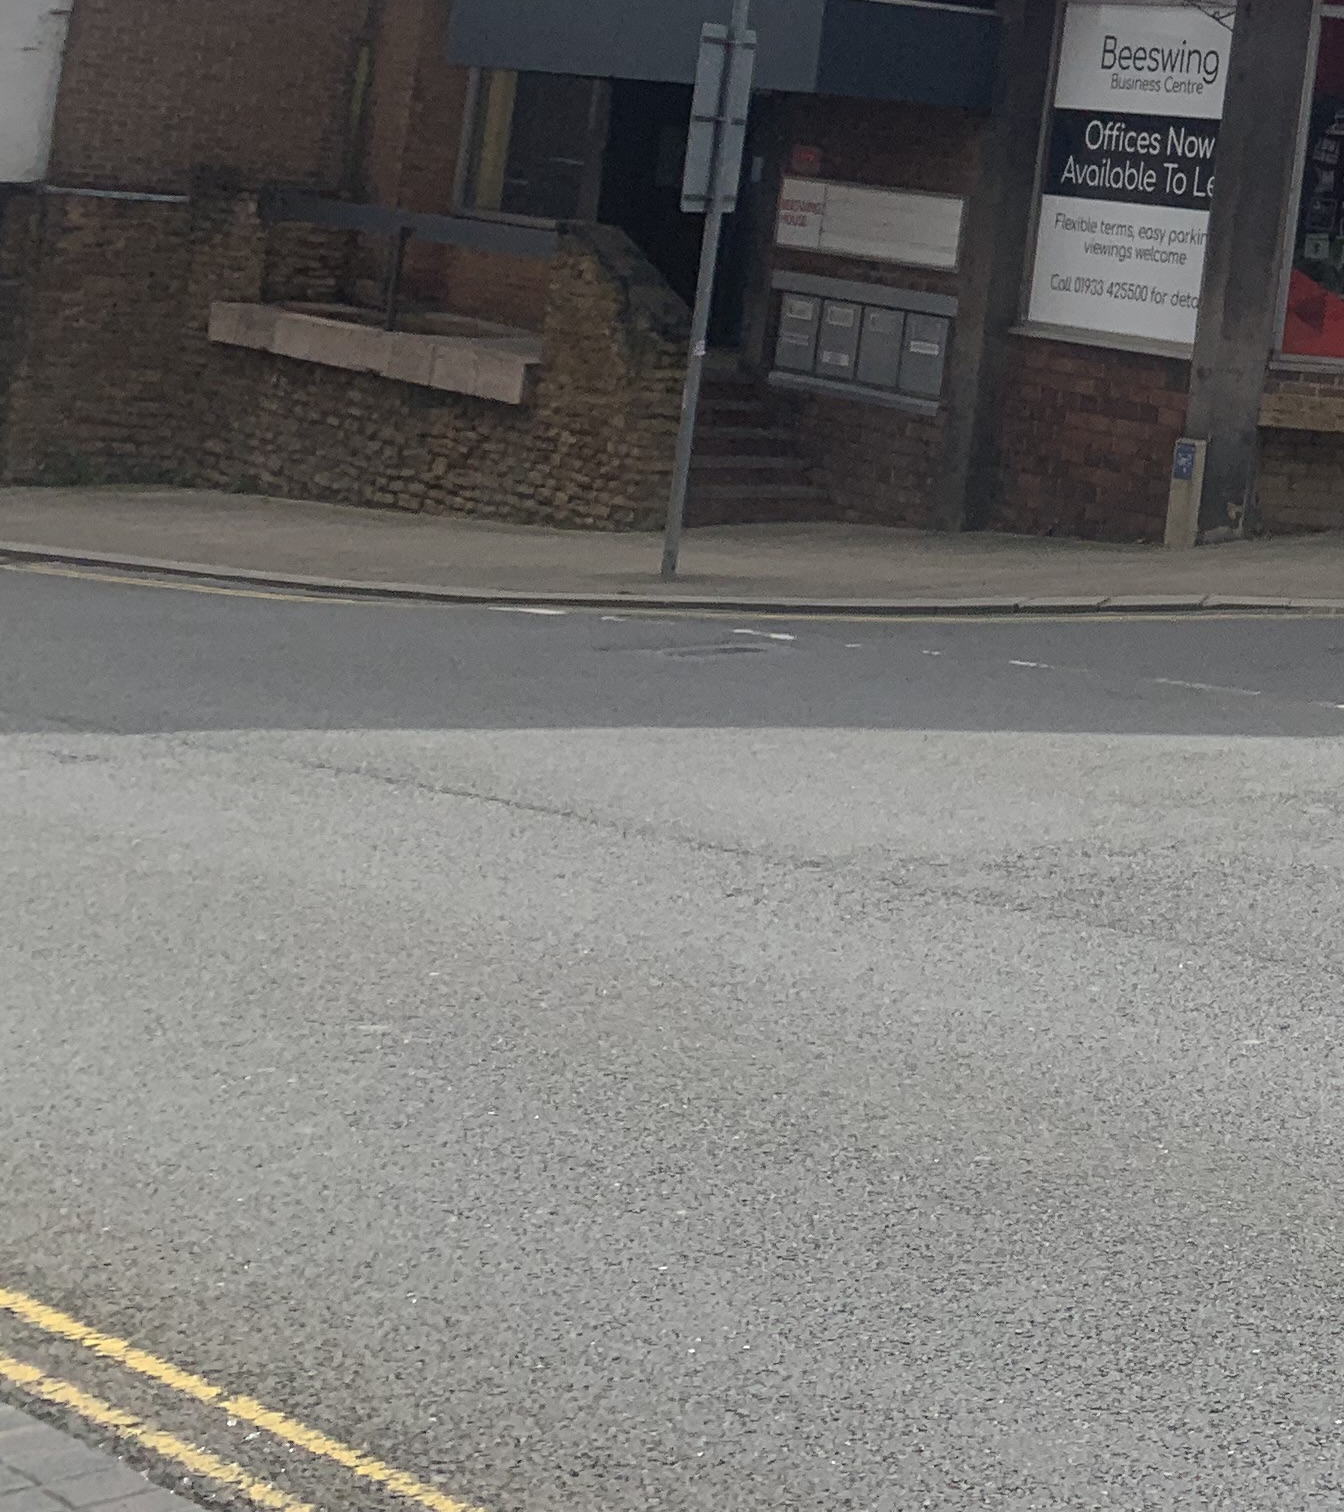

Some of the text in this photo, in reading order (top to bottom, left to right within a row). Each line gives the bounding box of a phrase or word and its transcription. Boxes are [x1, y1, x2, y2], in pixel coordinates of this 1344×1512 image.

[1101, 34, 1220, 84] Beeswing
[1110, 73, 1204, 95] Business Centre
[1084, 119, 1216, 160] Offices Now
[1060, 154, 1215, 198] Available To Le
[1054, 211, 1210, 248] Flexible terms, easy parkin
[1083, 241, 1187, 266] viewings welcome
[1050, 273, 1201, 310] Call 01933 425500 for deta
